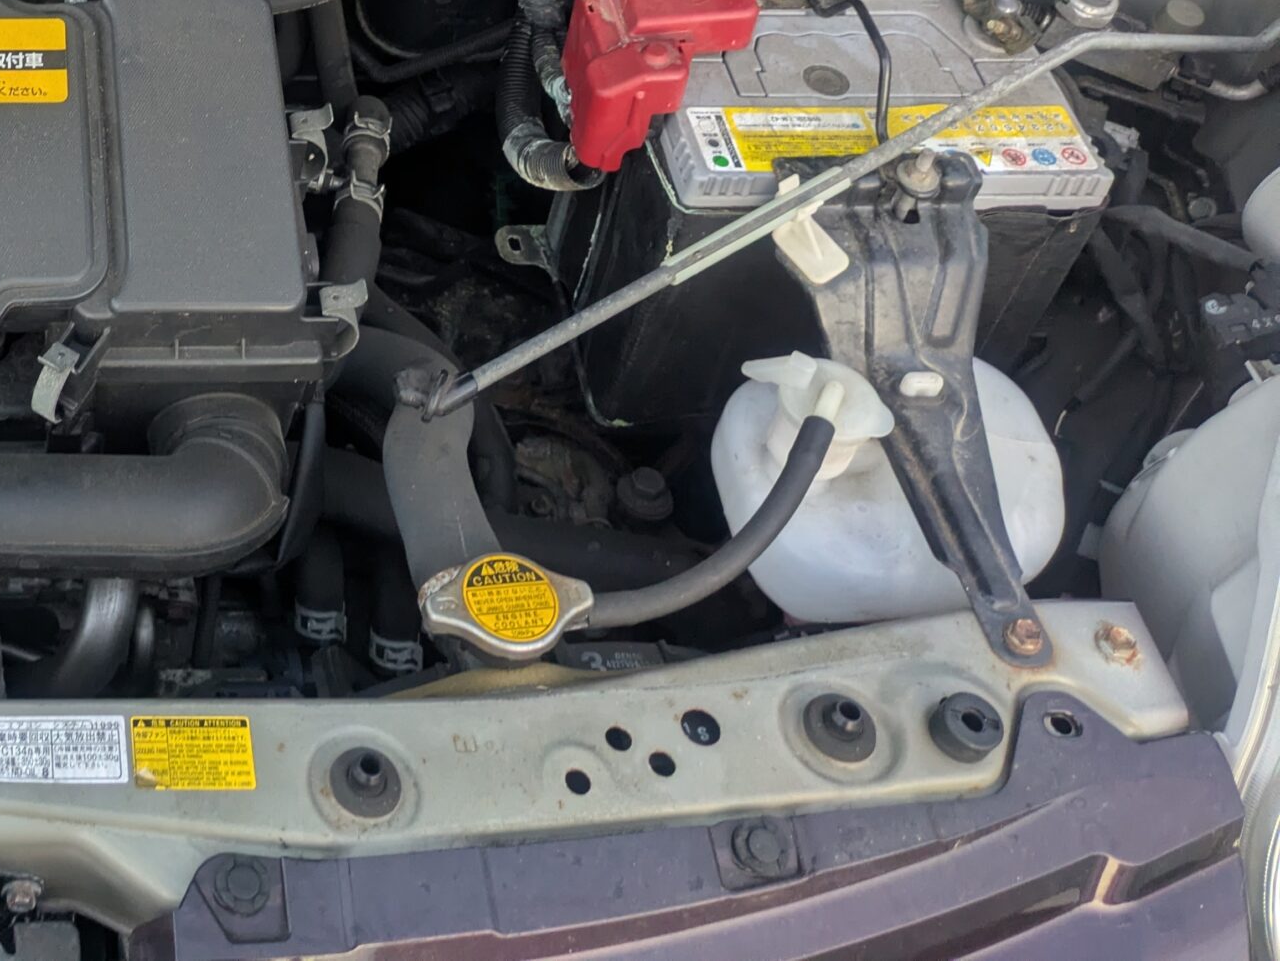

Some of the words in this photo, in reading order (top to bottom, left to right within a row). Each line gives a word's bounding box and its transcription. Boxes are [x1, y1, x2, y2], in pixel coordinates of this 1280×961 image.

[472, 571, 536, 587] CAUTION
[495, 610, 538, 621] ENGINE
[493, 618, 545, 628] COOLANT
[169, 719, 200, 728] CAUTION
[203, 719, 241, 728] ATTENTION
